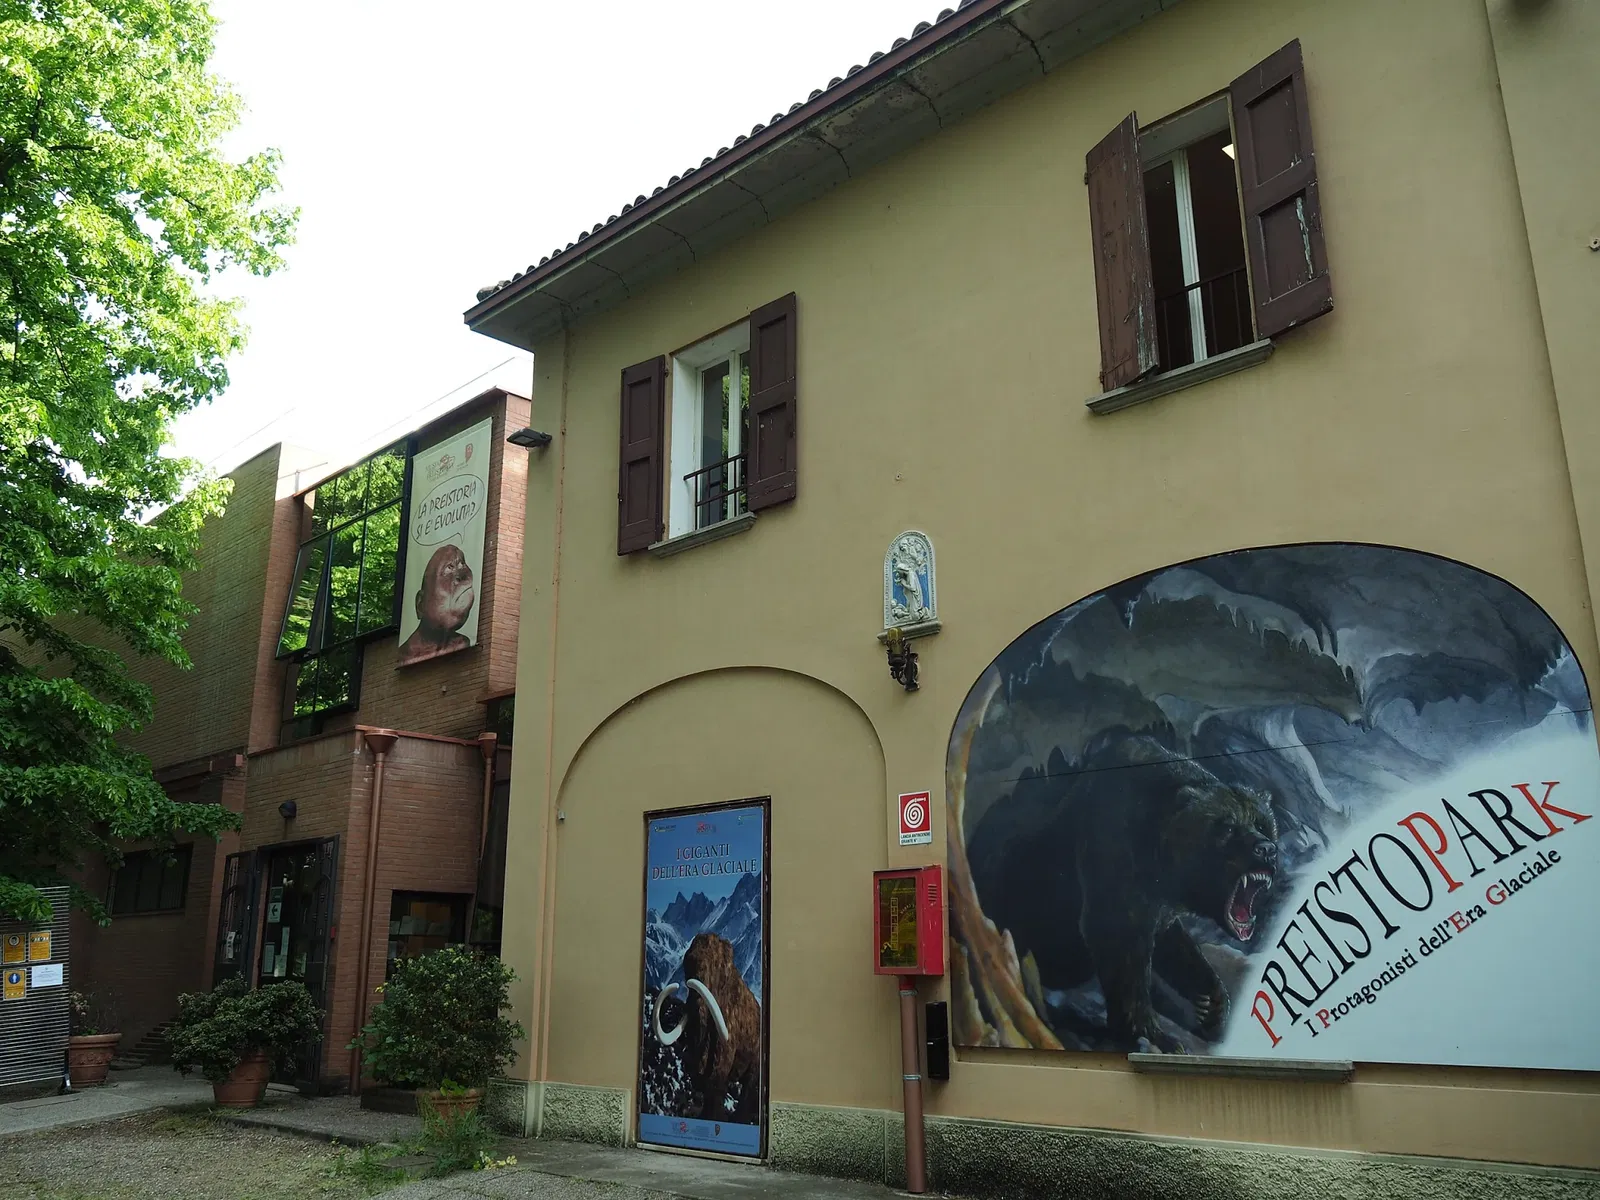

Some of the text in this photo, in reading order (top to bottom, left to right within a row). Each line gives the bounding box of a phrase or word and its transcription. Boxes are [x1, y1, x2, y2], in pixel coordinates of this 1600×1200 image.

[418, 480, 477, 519] LA PREISTORIA
[416, 523, 423, 540] SI
[434, 501, 476, 531] EVOLUTA?
[652, 859, 757, 881] DELL'ERA GLACIALE
[676, 843, 730, 861] I GIGANTI
[1250, 781, 1593, 1049] PREISTOPARK
[1304, 848, 1562, 1038] I Protagonisti dell'Era Glaciale
